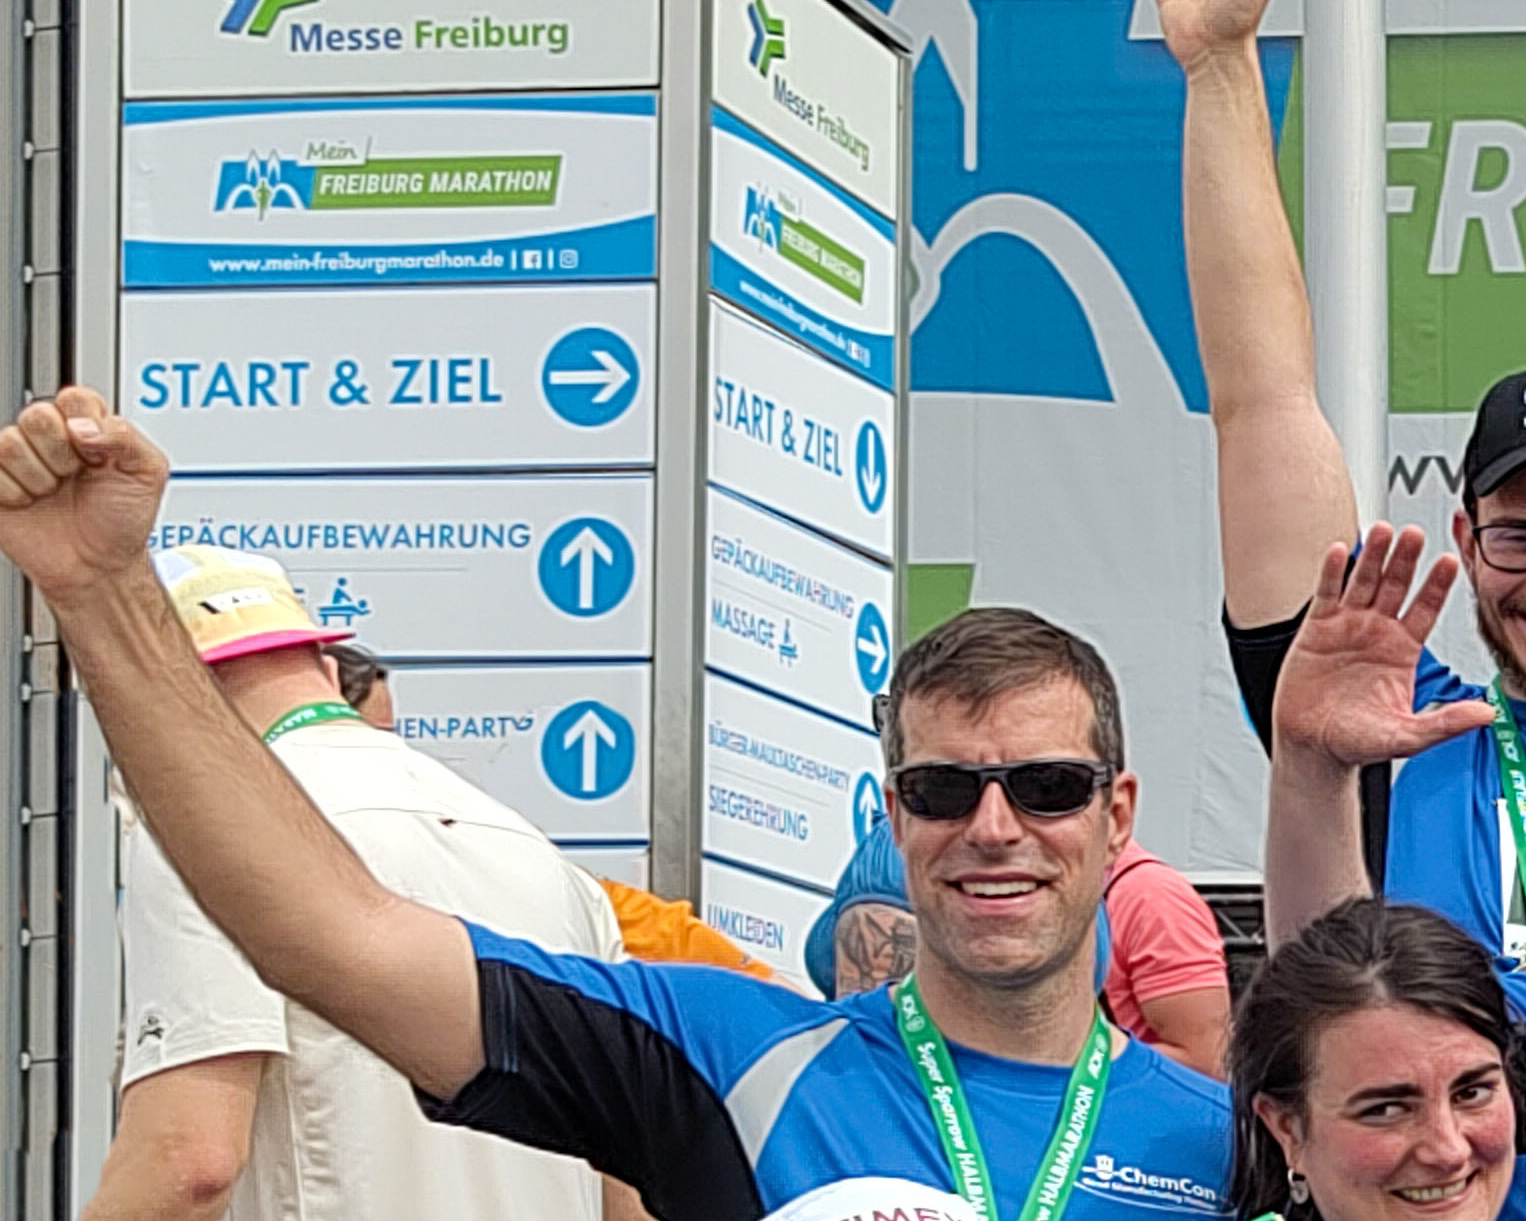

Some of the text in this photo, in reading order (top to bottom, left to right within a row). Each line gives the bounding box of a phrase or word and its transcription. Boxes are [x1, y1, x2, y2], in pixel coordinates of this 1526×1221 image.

[290, 18, 570, 54] Messe Freiburg
[774, 74, 869, 171] Messe Freiburg
[319, 169, 553, 197] FREIBURG MARATHON
[209, 251, 505, 275] www.mein-freiburgmarathon.de
[140, 359, 502, 409] START & ZIEL
[715, 377, 843, 477] START & ZIEL
[712, 535, 855, 619] GEPÄCKAUFBEWAHRUNG
[712, 598, 775, 650] MASSAGE
[916, 1041, 943, 1087] Super
[931, 1083, 970, 1151] Sparrow
[1039, 1084, 1096, 1208] HALBMARATHON
[1118, 1166, 1217, 1202] ChemCon
